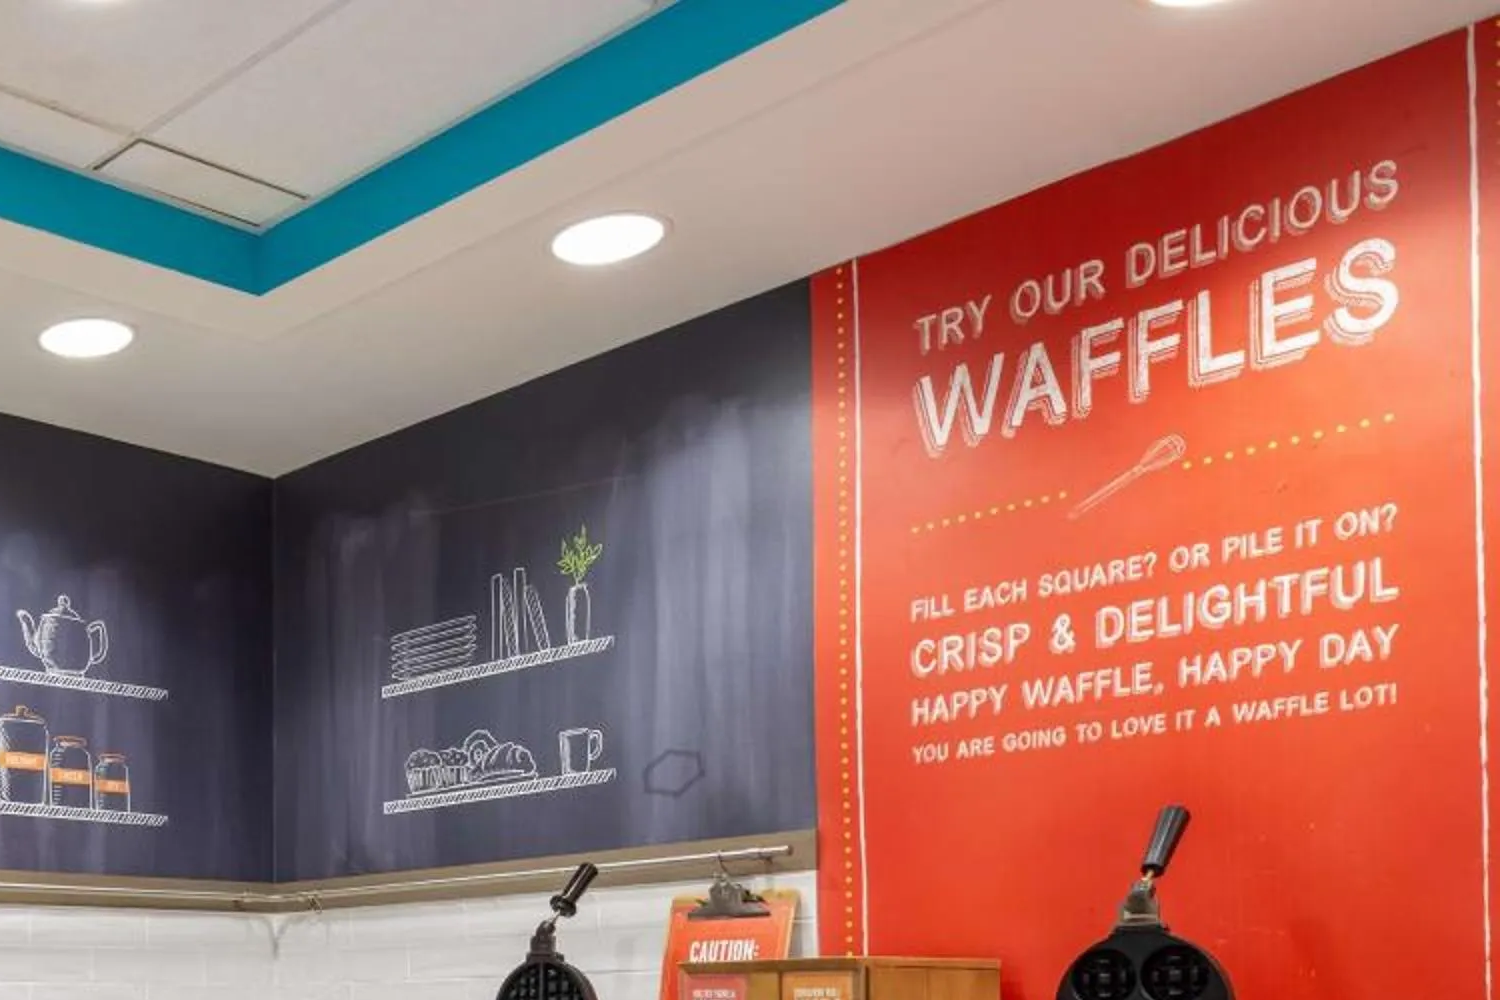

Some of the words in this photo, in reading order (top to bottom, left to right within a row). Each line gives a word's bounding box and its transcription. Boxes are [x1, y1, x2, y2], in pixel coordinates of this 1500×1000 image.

[914, 294, 992, 355] TRY
[1009, 259, 1106, 325] OUR
[1125, 159, 1400, 289] DELICIOUS
[913, 237, 1399, 458] WAFFLES
[911, 594, 955, 622] FILL
[964, 578, 1027, 612] EACH
[1038, 552, 1157, 598] SQUARE?
[1169, 543, 1210, 573] OR
[1221, 526, 1284, 564] PILE
[1295, 518, 1322, 549] IT
[1333, 502, 1398, 541] ON?
[911, 622, 1031, 678] CRISP
[1050, 613, 1076, 654] &
[1095, 556, 1399, 649] DELIGHTFUL
[911, 684, 1008, 727] HAPPY
[1178, 639, 1303, 688] HAPPY
[1319, 623, 1399, 669] DAY
[912, 741, 949, 765] YOU
[956, 736, 995, 760] ARE
[1002, 726, 1068, 753] GOING
[1076, 721, 1103, 743] TO
[1111, 713, 1167, 740] LOVE
[1176, 709, 1196, 731] IT
[1205, 705, 1221, 728] A
[1232, 691, 1329, 725] WAFFLE
[1339, 682, 1397, 710] LOT!
[690, 938, 760, 964] CAUTION:
